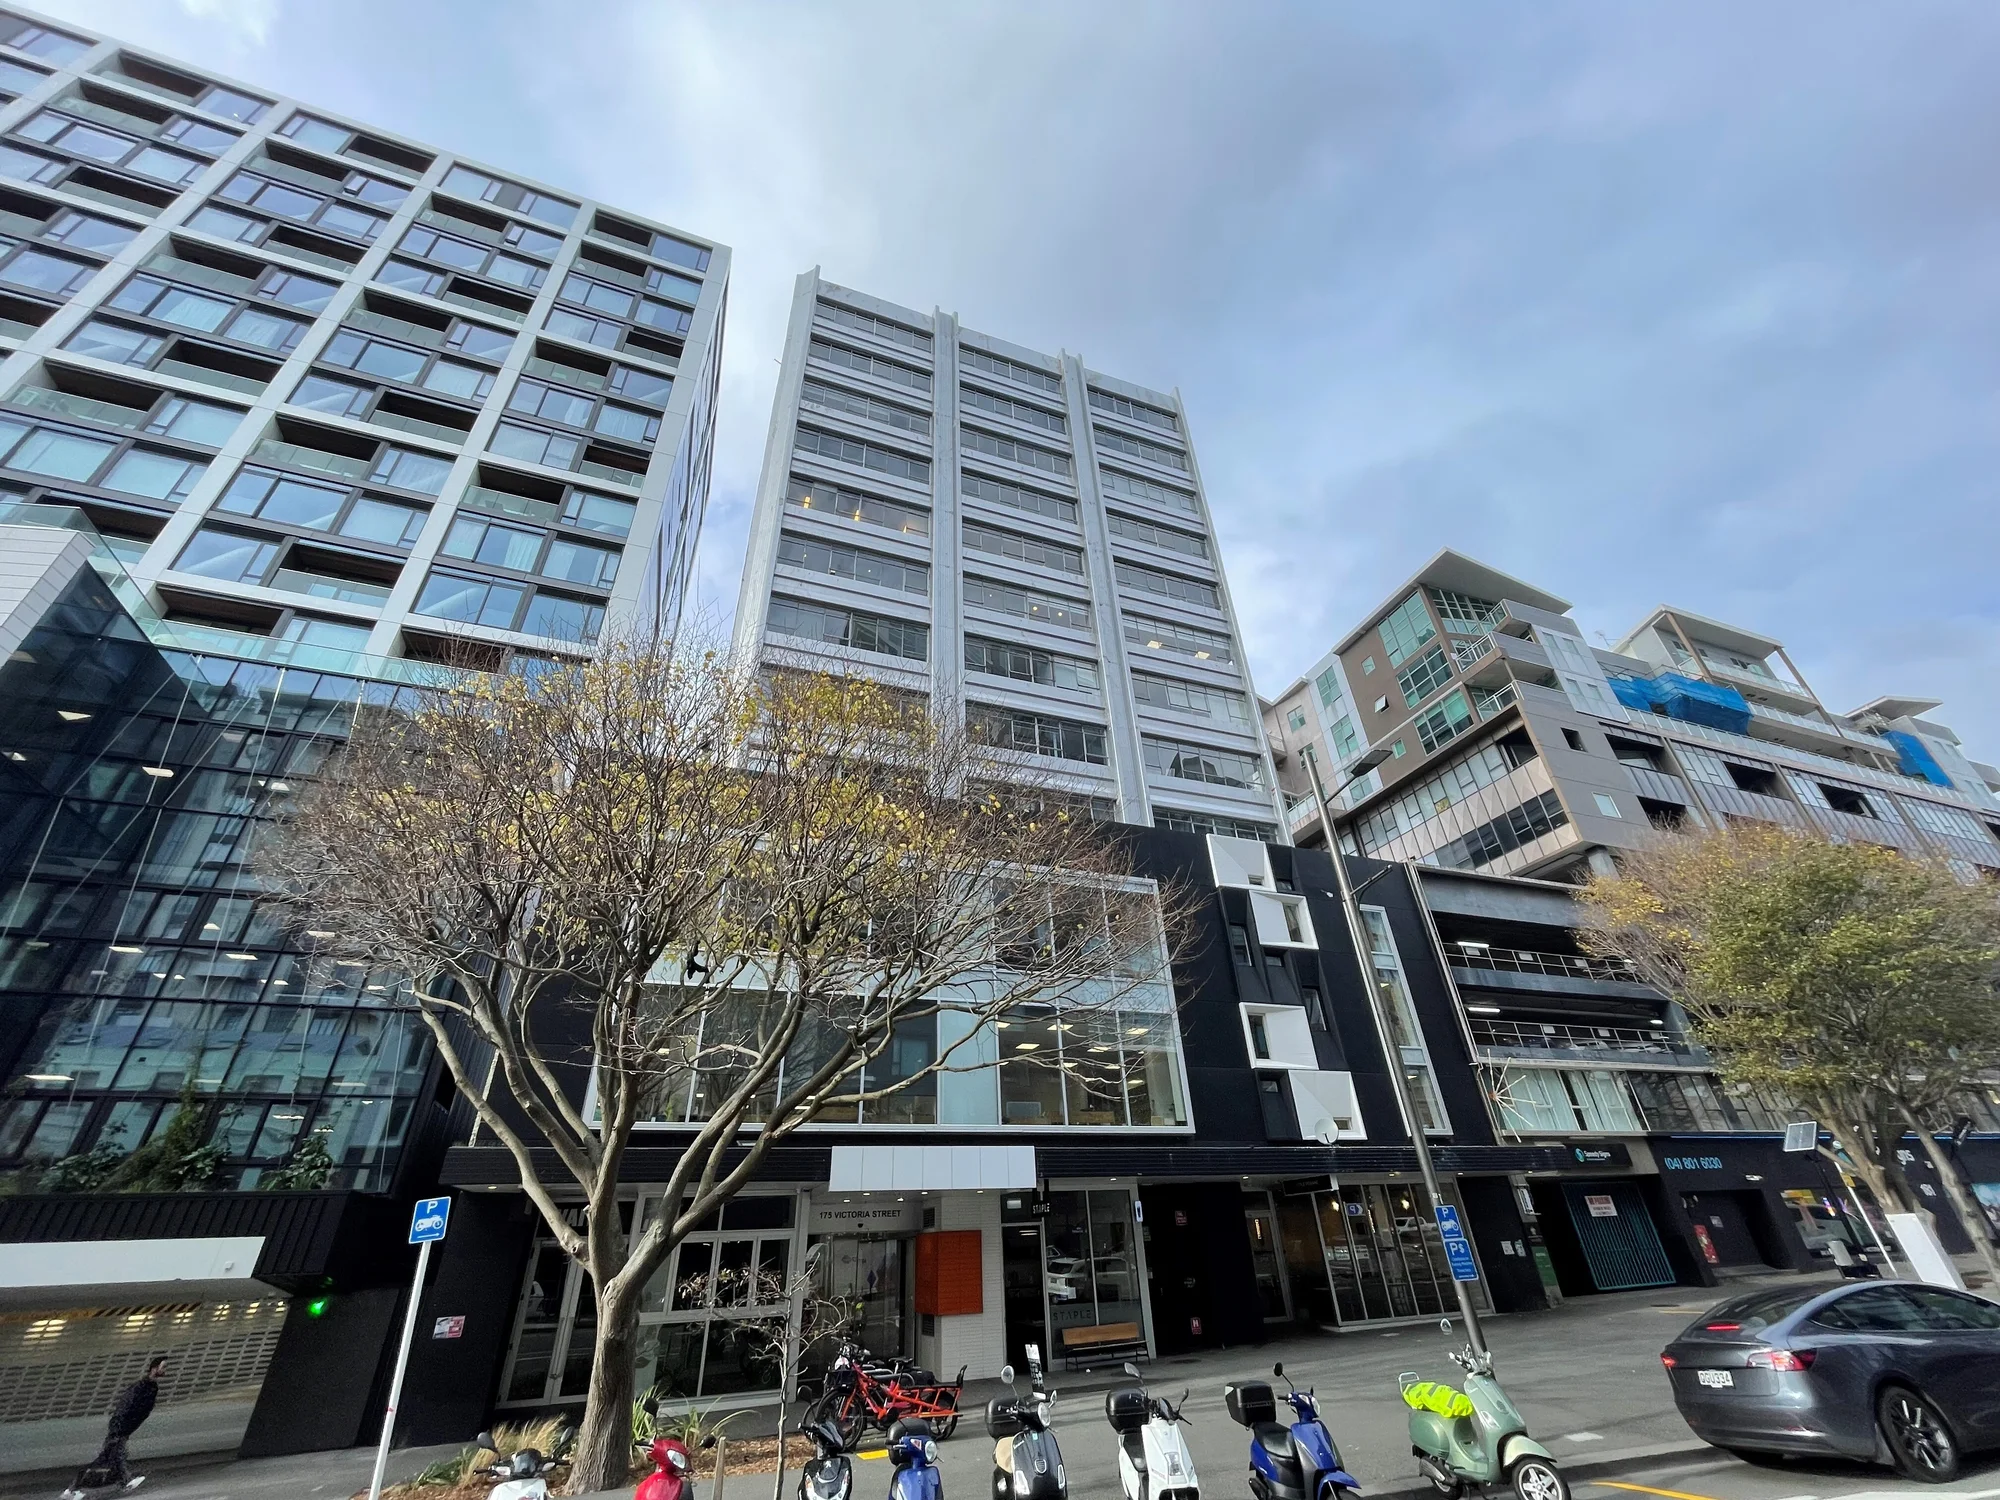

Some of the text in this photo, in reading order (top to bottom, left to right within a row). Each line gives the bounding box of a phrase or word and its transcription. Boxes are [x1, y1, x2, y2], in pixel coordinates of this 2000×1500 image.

[1664, 1157, 1722, 1170] (04) 801 6030
[427, 1201, 438, 1214] P
[1032, 1203, 1050, 1214] STAPLE
[1441, 1208, 1449, 1218] P
[834, 1211, 870, 1219] VICTORIA
[872, 1210, 901, 1218] STREET
[1053, 1310, 1092, 1321] STAPLE
